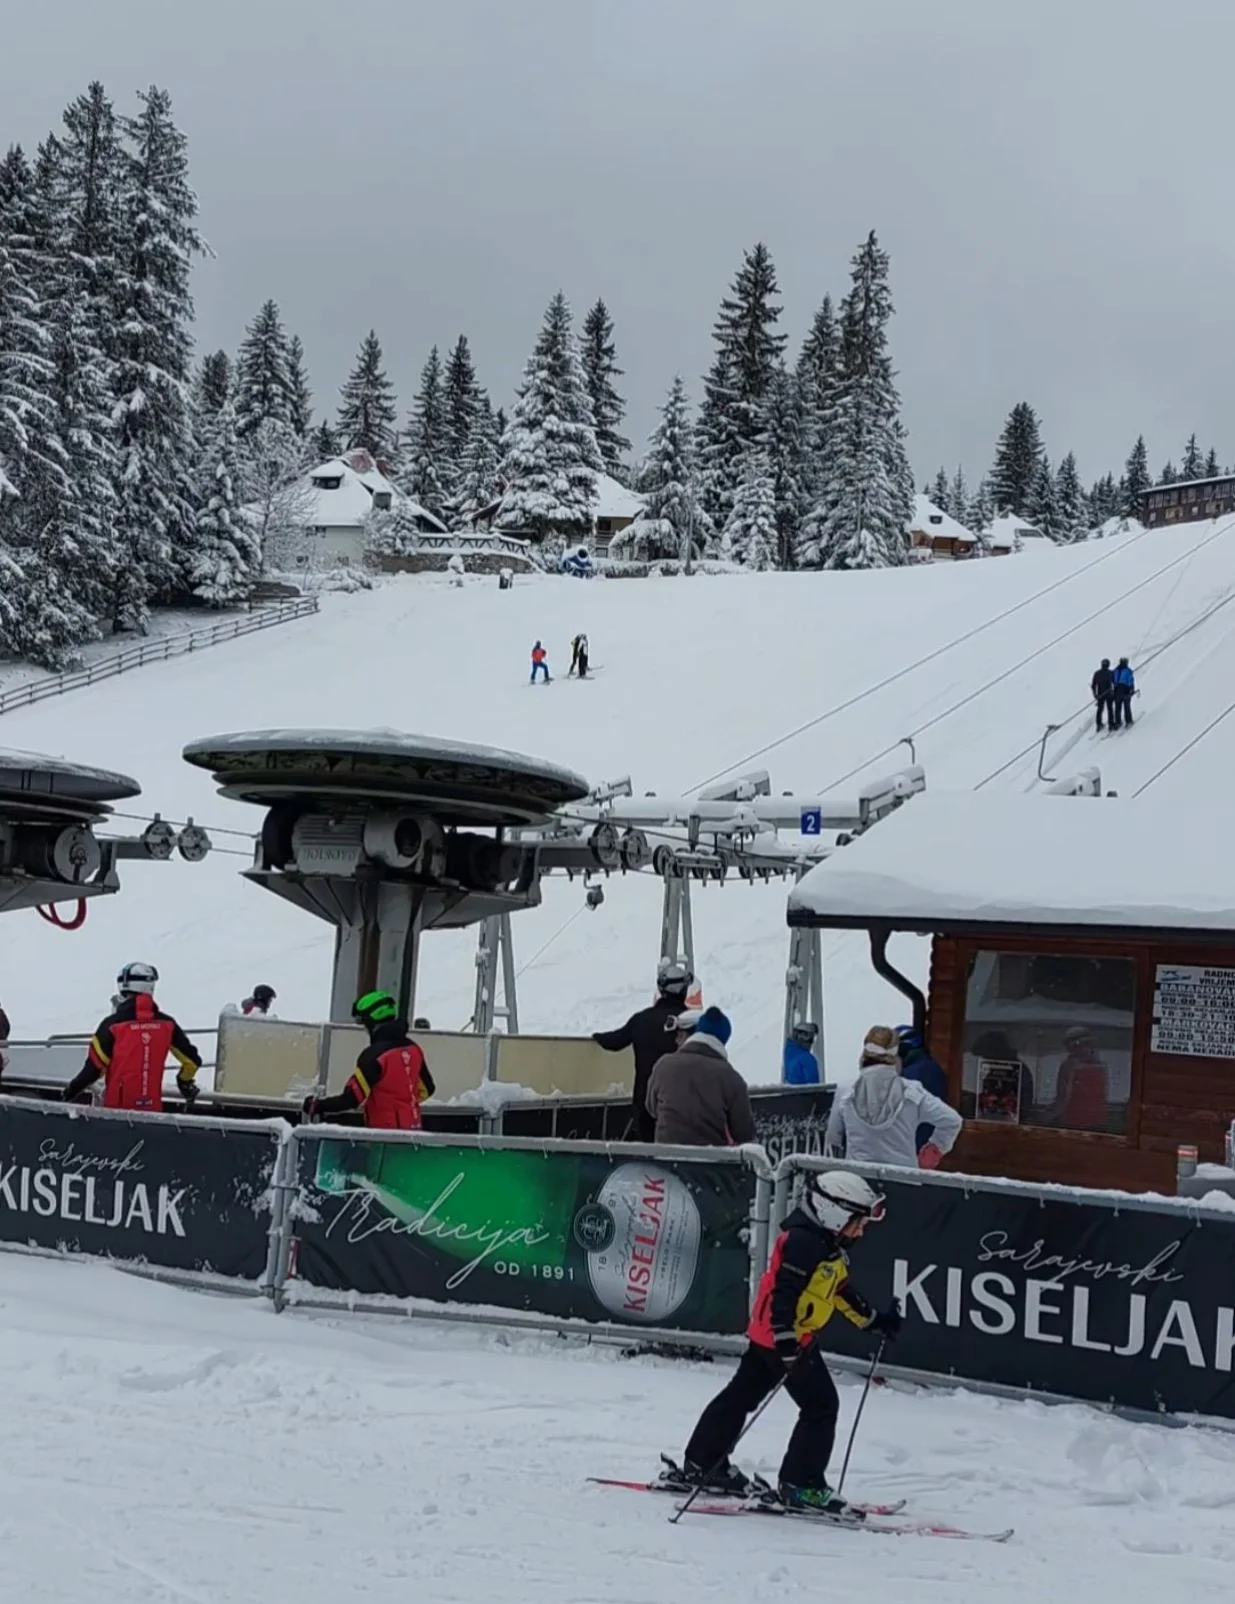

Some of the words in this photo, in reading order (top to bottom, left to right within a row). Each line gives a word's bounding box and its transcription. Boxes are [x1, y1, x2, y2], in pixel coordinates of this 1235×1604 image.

[806, 814, 816, 832] 2
[38, 1138, 146, 1178] Sarajevski
[0, 1164, 187, 1238] KISELJAK
[325, 1172, 550, 1289] Tradicija
[494, 1260, 520, 1276] OD
[531, 1263, 575, 1282] 1891
[624, 1174, 666, 1312] KISELJAK
[977, 1231, 1185, 1293] Sarajevski
